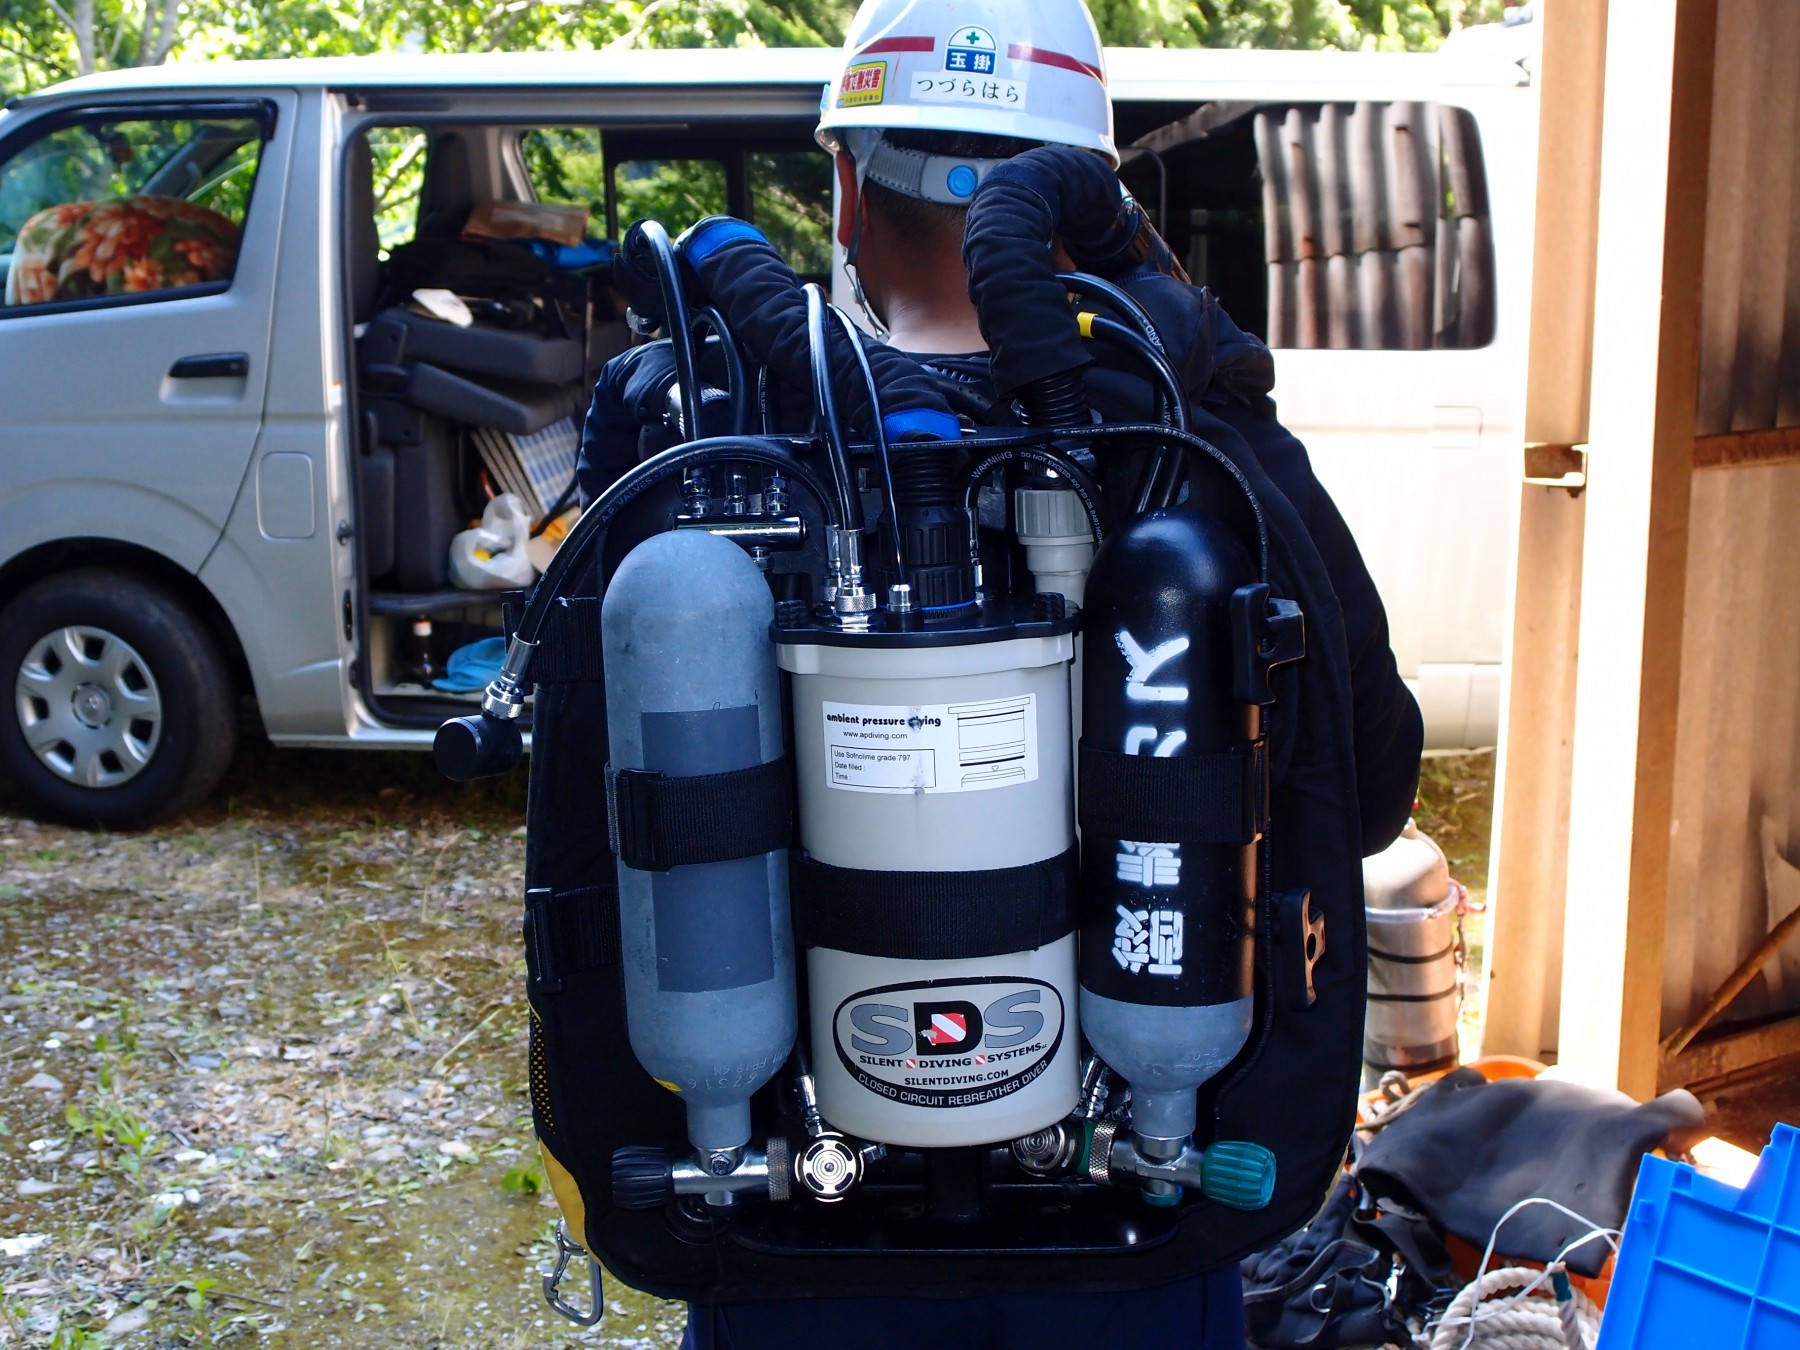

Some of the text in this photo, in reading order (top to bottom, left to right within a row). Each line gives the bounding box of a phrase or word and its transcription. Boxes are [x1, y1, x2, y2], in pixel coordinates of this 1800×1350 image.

[949, 52, 991, 71] 玉掛
[917, 78, 1019, 103] つづらはら
[971, 451, 1013, 478] WARNING
[1032, 454, 1047, 463] NOT
[1048, 459, 1071, 479] EXCEED
[826, 713, 859, 724] ambient
[862, 717, 905, 727] pressure
[843, 730, 907, 740] www.apdiving.com
[877, 754, 896, 762] grade
[850, 990, 1044, 1056] SDS
[859, 1055, 904, 1068] SILENT
[919, 1057, 972, 1068] DIVING
[987, 1042, 1042, 1063] SYSTEMS
[858, 1060, 1048, 1106] CLOSED CIRCUIT REBREATHER DIVER
[904, 1069, 1009, 1086] SILENTDIVING.COM
